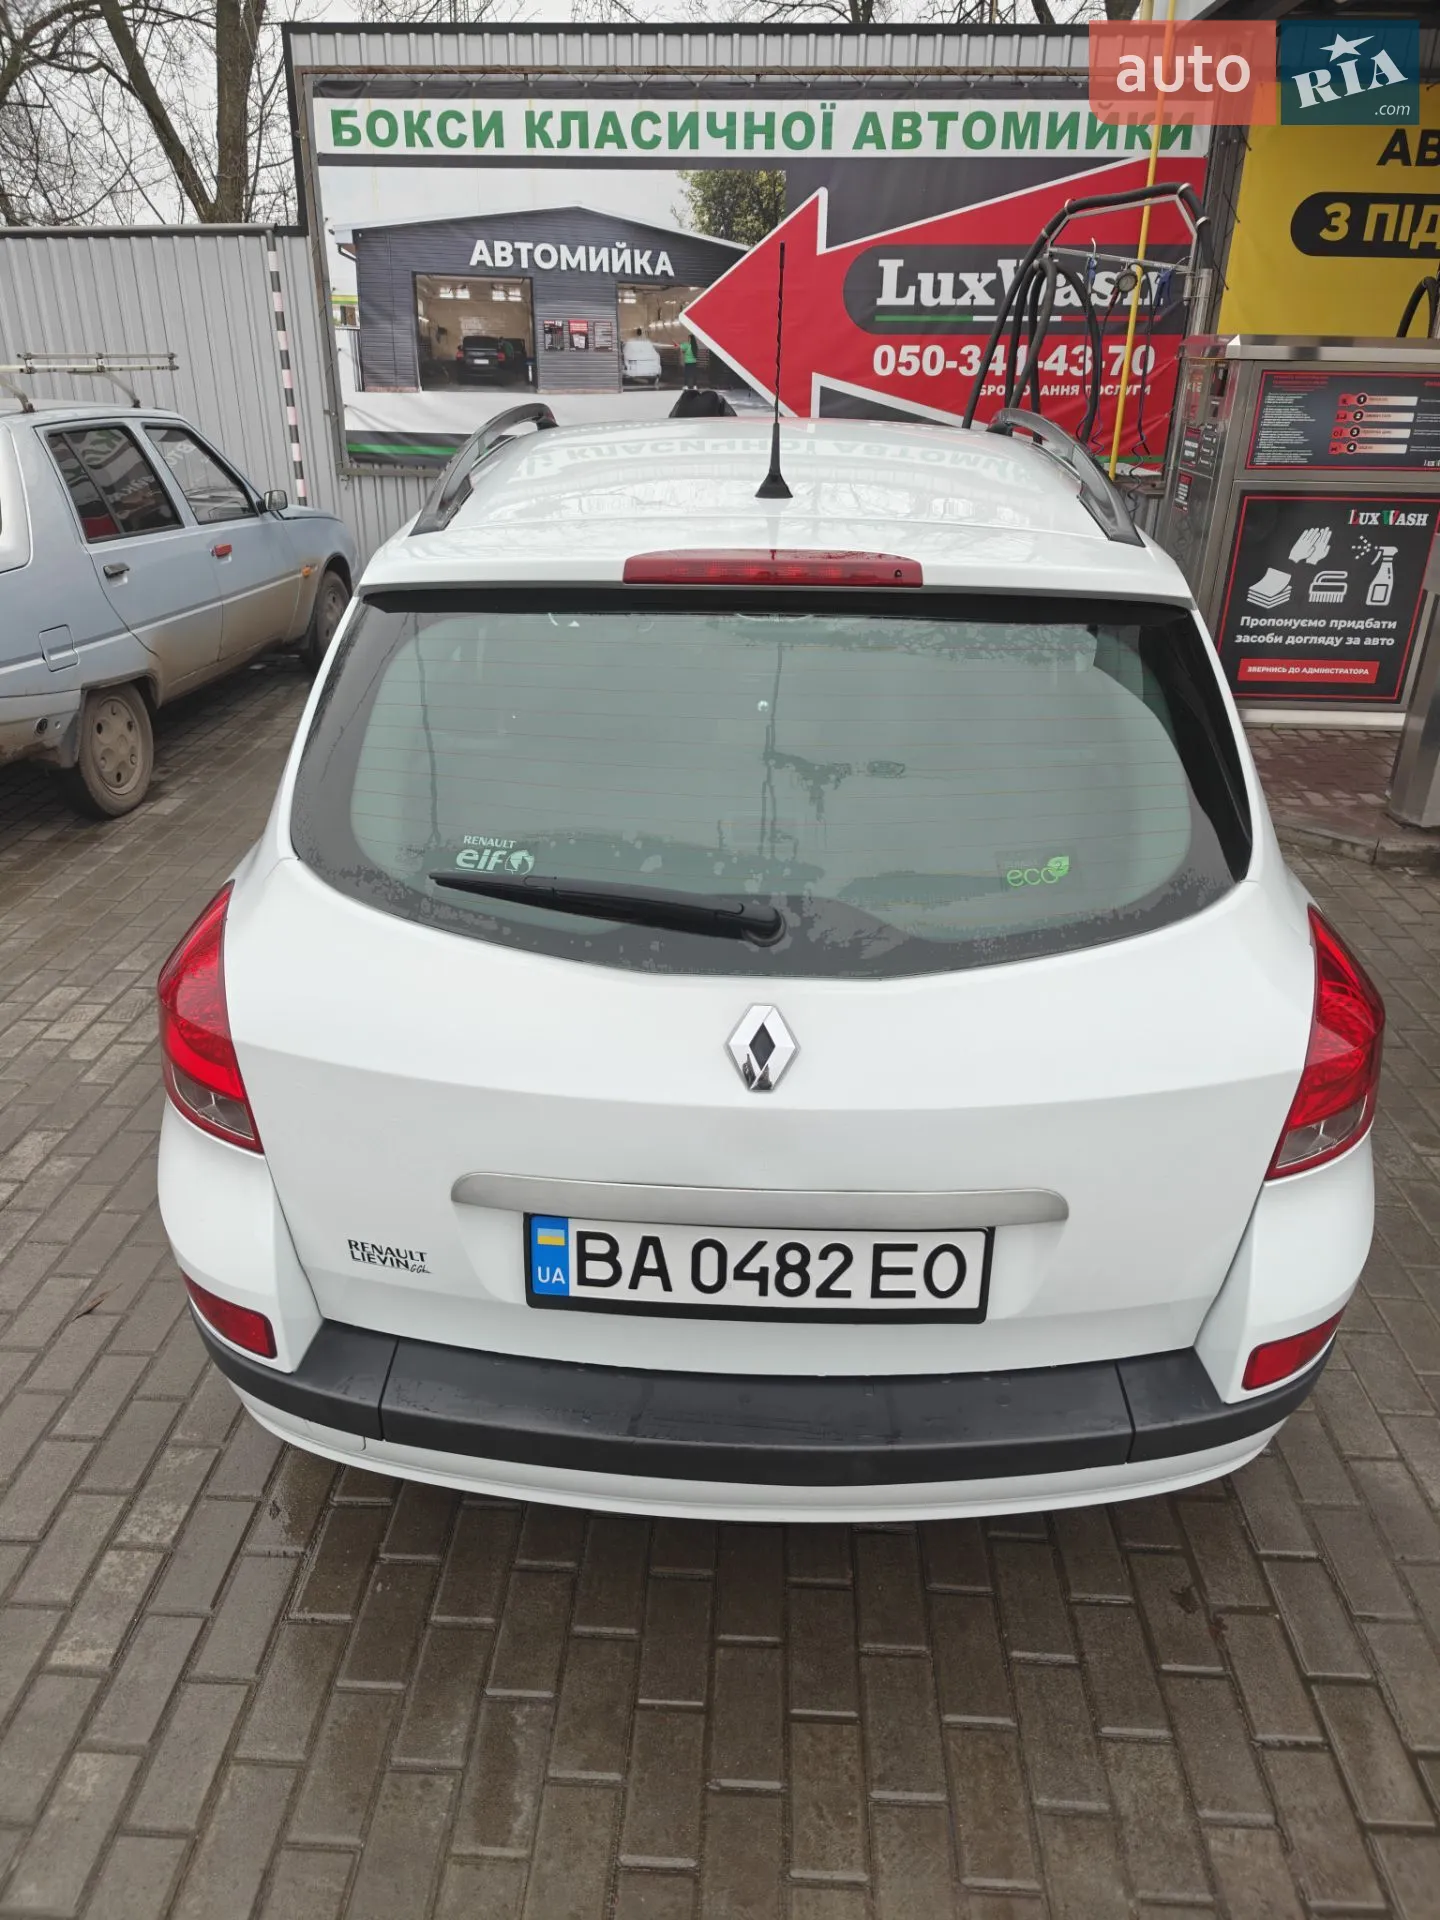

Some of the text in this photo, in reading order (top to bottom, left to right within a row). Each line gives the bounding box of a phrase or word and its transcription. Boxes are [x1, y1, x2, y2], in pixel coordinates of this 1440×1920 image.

[331, 101, 1195, 151] БОКСИ КЛАСИЧНОЇ АВТОМИЙКИ
[469, 239, 675, 277] АВТОМИЙКА
[873, 343, 1156, 377] 050-341-4370
[979, 384, 1080, 397] БРОАННЯ
[1348, 509, 1430, 528] LUX WASH
[1240, 616, 1398, 630] Пропонуємо придбати
[1235, 632, 1395, 647] засоби догляду за авто
[463, 834, 517, 849] RENAULT
[455, 849, 507, 871] elf
[347, 1239, 428, 1262] RENAULT
[350, 1250, 410, 1269] LIEVIN
[576, 1230, 967, 1299] BA 0482 EO
[538, 1266, 566, 1284] UA
